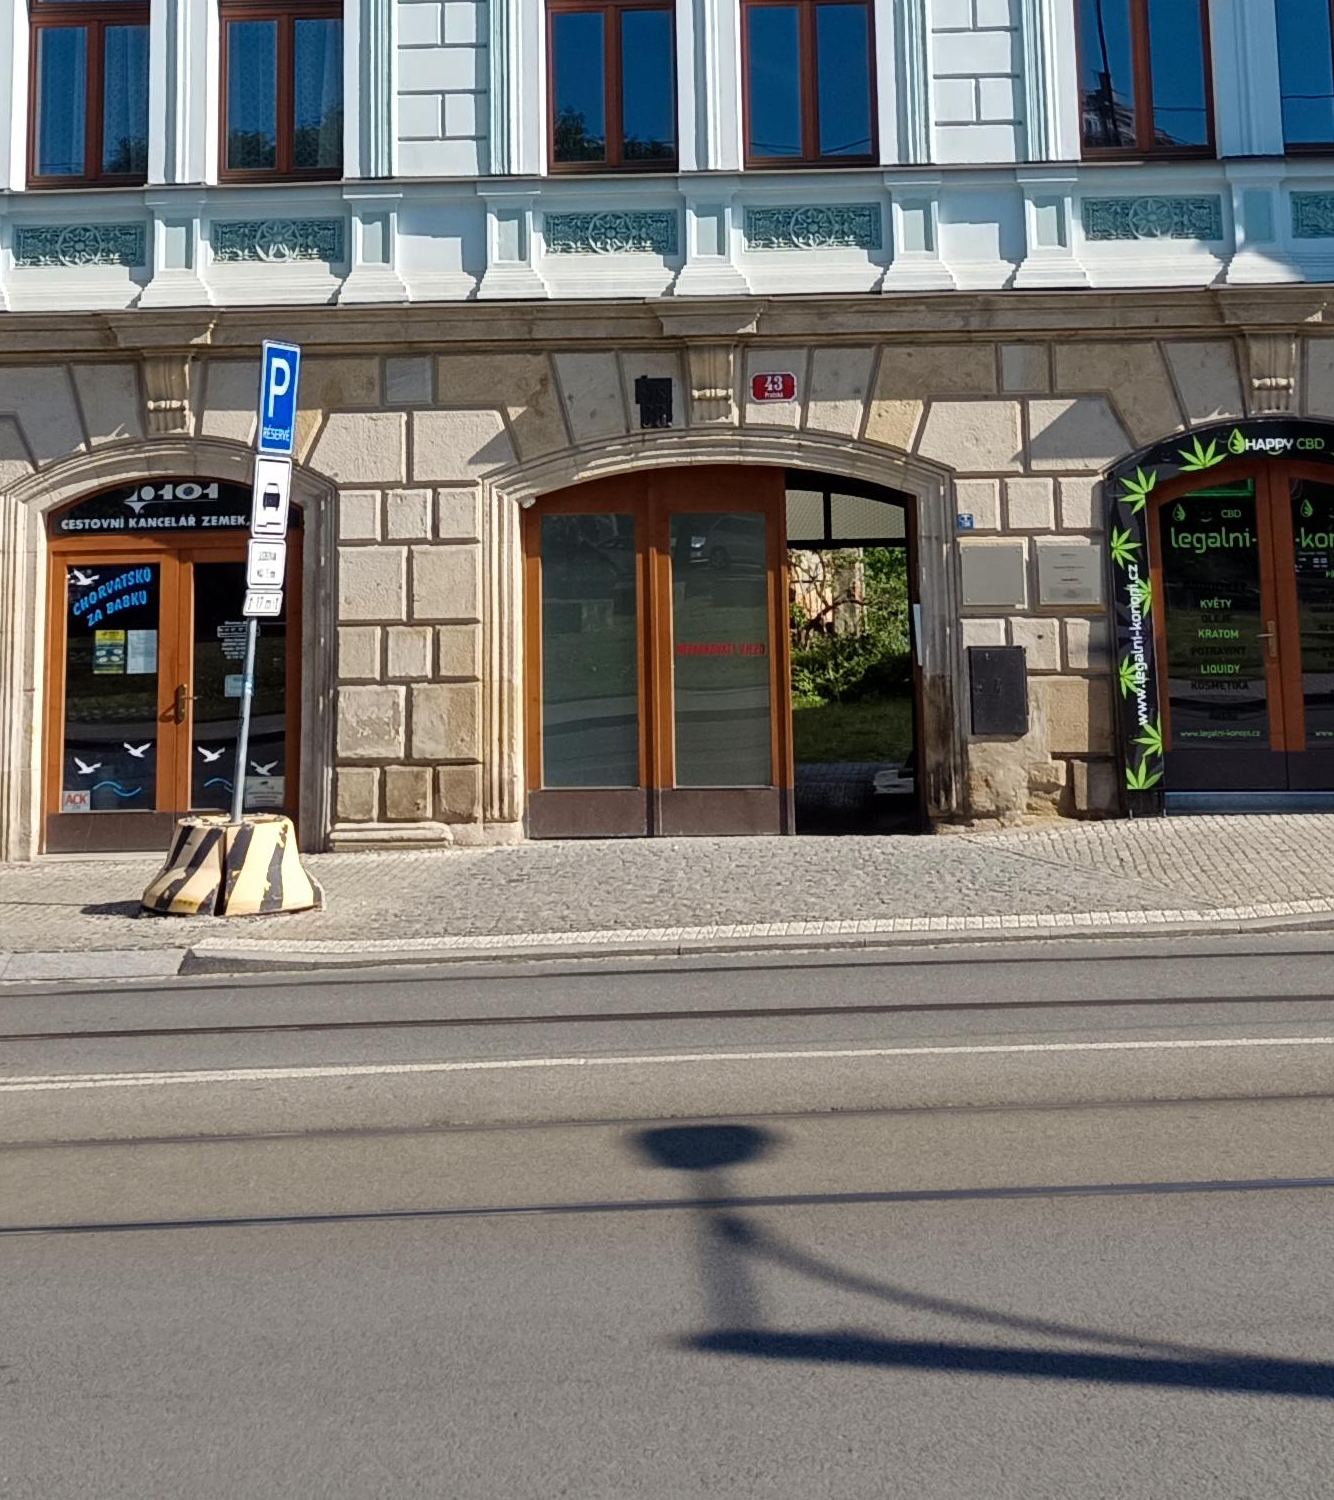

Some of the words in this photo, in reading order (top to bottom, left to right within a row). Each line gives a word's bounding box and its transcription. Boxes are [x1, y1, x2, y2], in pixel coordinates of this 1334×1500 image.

[268, 357, 290, 418] P
[764, 375, 783, 391] 43
[1246, 438, 1294, 451] HAPPY
[1296, 437, 1325, 450] CBD
[61, 515, 125, 530] CESTOVNÍ
[128, 513, 197, 528] KANCELÁŘ
[1221, 509, 1242, 518] CBD
[1170, 526, 1258, 553] legalni-
[73, 567, 151, 616] CHORVATSKO
[87, 609, 104, 627] ZA
[106, 590, 147, 614] BABKU
[1199, 596, 1232, 609] KVĚTY
[1197, 628, 1239, 639] KRATOM
[1128, 564, 1149, 726] www.legalni-konopi.cz
[1200, 664, 1240, 674] LIQUIDY
